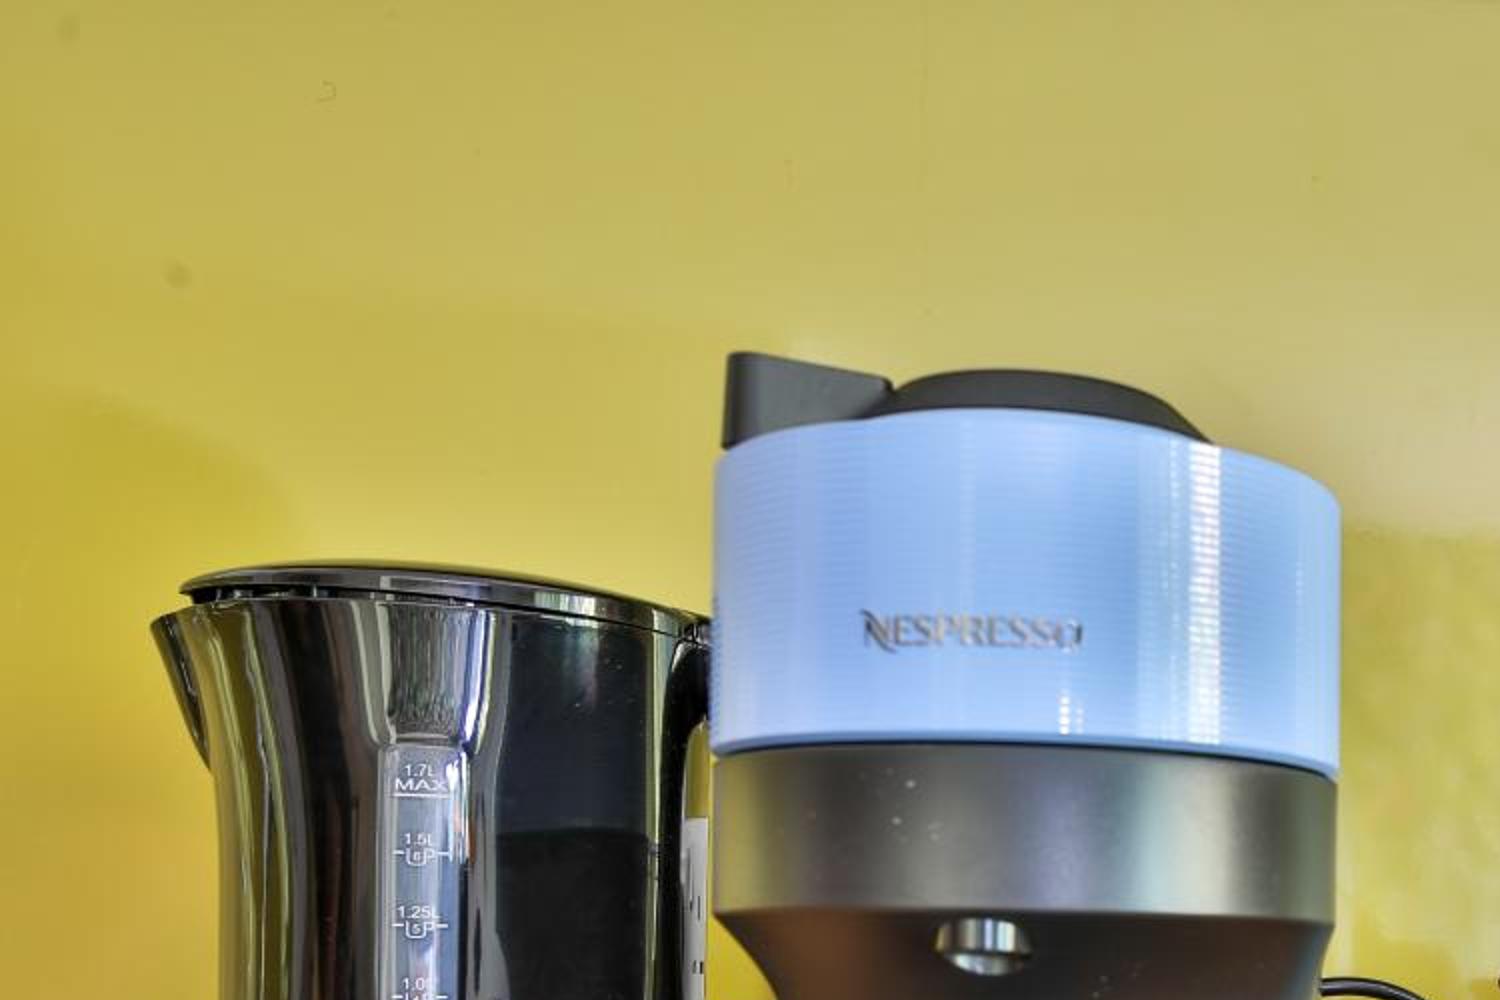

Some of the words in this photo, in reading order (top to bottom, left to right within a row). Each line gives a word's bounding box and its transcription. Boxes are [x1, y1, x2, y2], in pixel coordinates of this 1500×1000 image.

[859, 608, 1083, 654] NESPRESSO
[405, 763, 434, 777] 1.7L
[395, 779, 448, 791] MAX
[404, 833, 434, 846] 1.5L
[397, 905, 441, 919] 1.25L
[402, 977, 432, 991] 1.0
